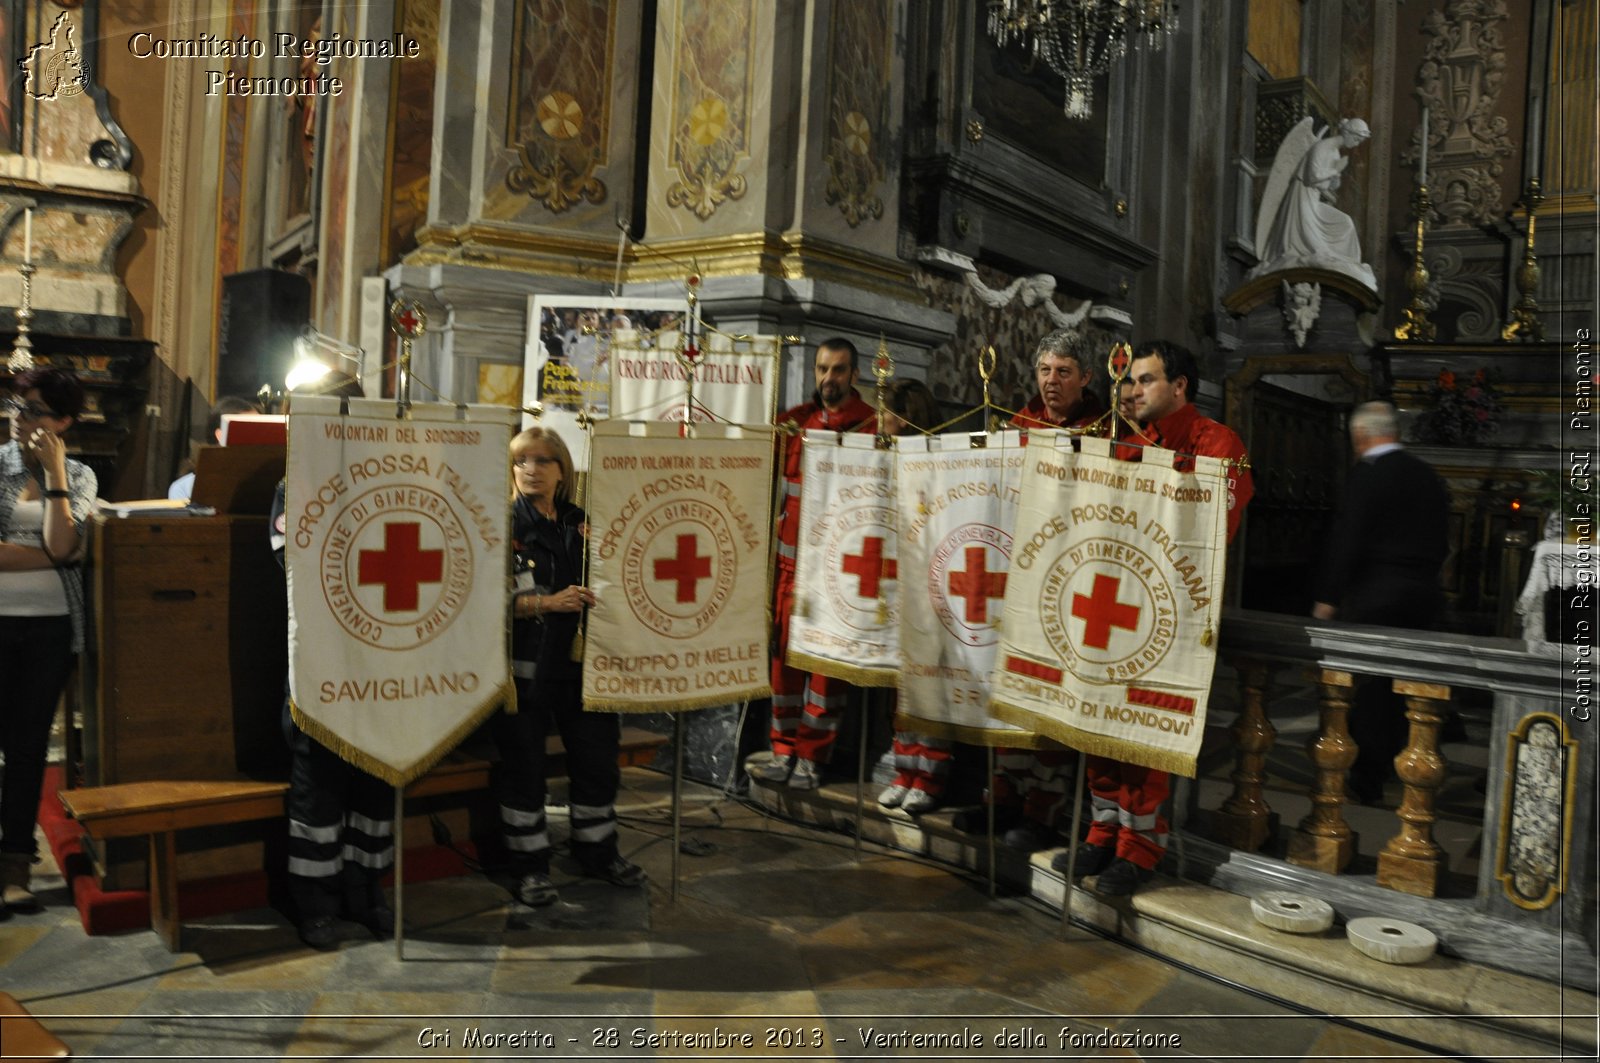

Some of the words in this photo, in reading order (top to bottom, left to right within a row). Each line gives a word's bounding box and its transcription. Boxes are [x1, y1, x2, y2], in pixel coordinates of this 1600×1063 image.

[618, 359, 658, 380] CROCE
[702, 363, 764, 385] ITALIANA
[325, 423, 388, 443] VOLONTARI
[396, 428, 417, 443] DEL
[425, 429, 481, 446] SOCCORSO
[602, 456, 637, 470] CORPO
[641, 455, 695, 471] VOLONTARI
[699, 456, 716, 470] DEL
[986, 458, 1004, 468] DEL
[947, 482, 1000, 503] ROSSA
[1003, 486, 1021, 505] IT
[1036, 461, 1066, 480] CORPO
[1071, 467, 1129, 490] VOLONTARI
[1135, 479, 1157, 495] DEL
[1161, 483, 1212, 503] SOCCORSO
[295, 474, 348, 549] CROCE
[349, 454, 431, 484] ROSSA
[351, 506, 369, 523] DI
[375, 490, 446, 519] GINEVRA
[600, 493, 642, 561] CROCE
[642, 473, 706, 498] ROSSA
[711, 480, 761, 554] ITALIANA
[643, 516, 660, 534] DI
[1016, 516, 1068, 571] CROCE
[1071, 503, 1139, 530] ROSSA
[1144, 519, 1212, 612] ITALIANA
[1070, 549, 1084, 566] DI
[1087, 543, 1154, 580] GINEVRA
[326, 523, 382, 642] CONVENZIONE
[1152, 582, 1169, 602] 22
[1142, 607, 1172, 662] AGOSTO
[593, 653, 678, 673] GRUPPO
[685, 651, 700, 668] DI
[704, 643, 761, 667] MELLE
[1106, 658, 1145, 680] 1864
[319, 671, 480, 703] SAVIGLIANO
[594, 675, 688, 695] COMITATO
[695, 667, 758, 689] LOCALE
[1002, 676, 1076, 710] COMITATO
[1080, 700, 1098, 718] DI
